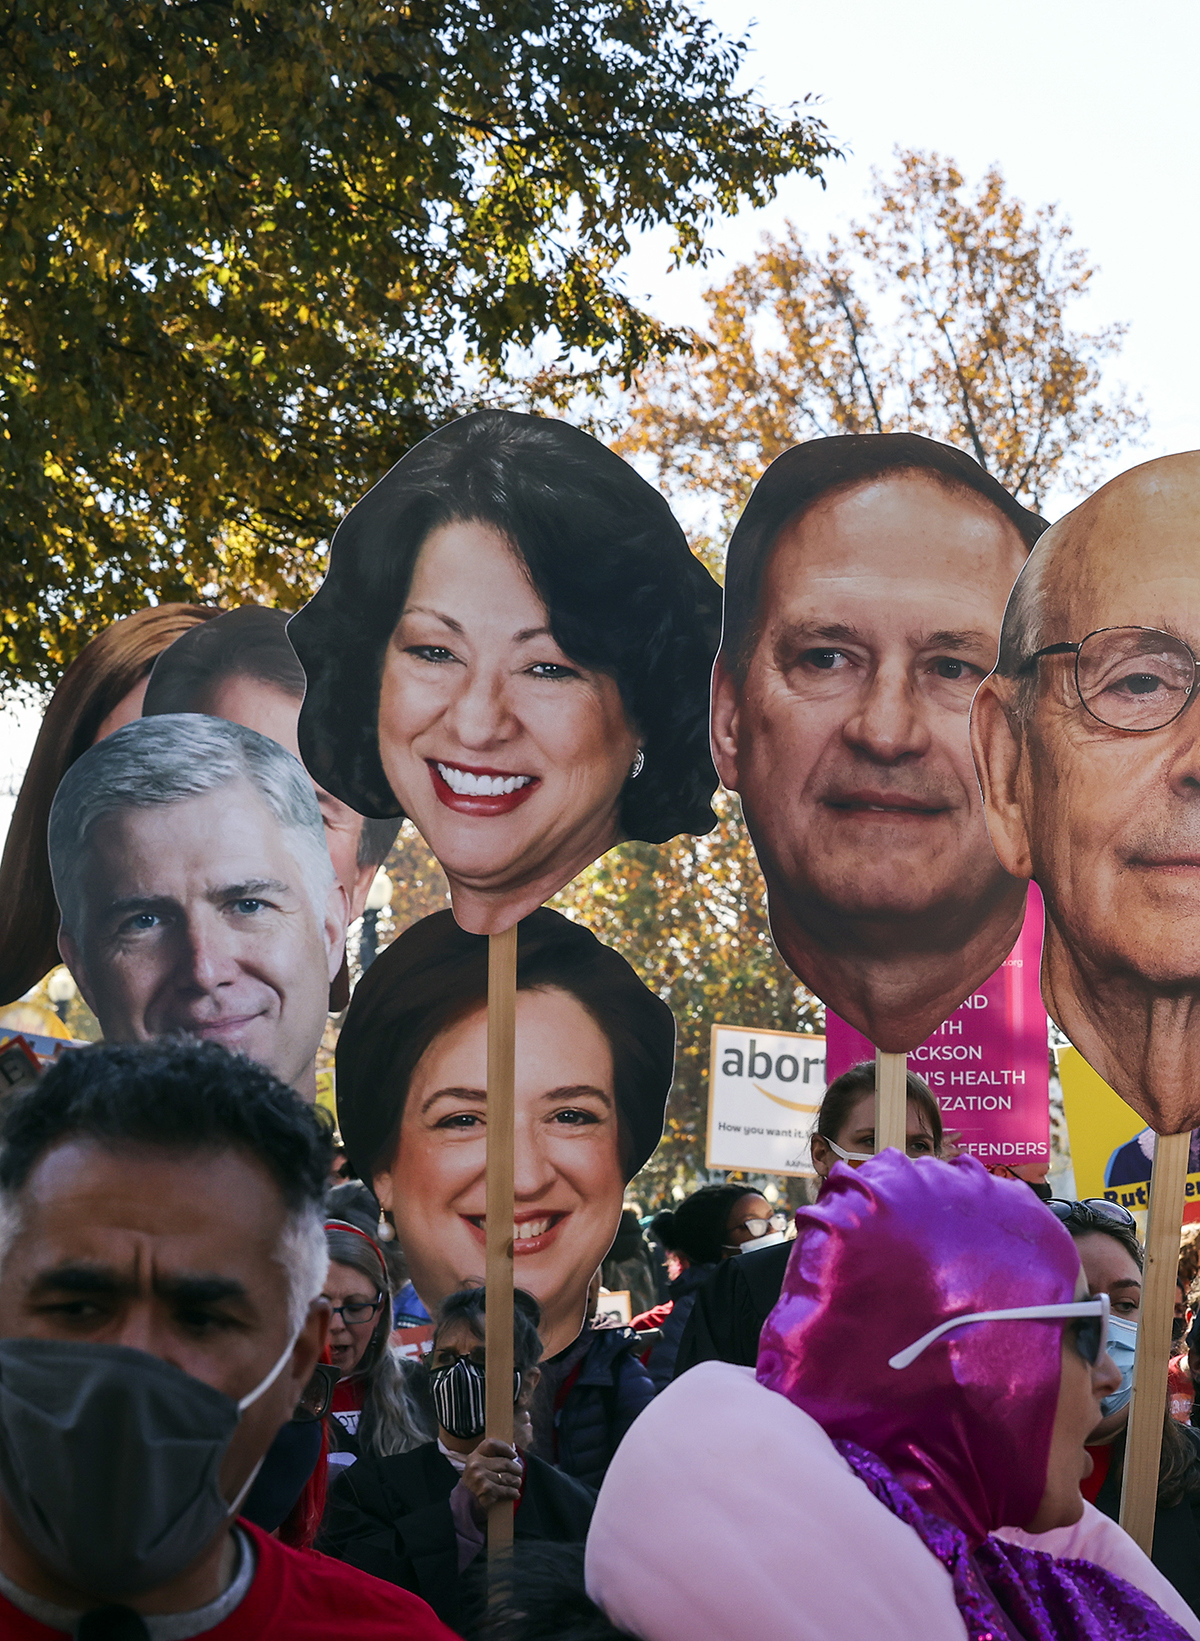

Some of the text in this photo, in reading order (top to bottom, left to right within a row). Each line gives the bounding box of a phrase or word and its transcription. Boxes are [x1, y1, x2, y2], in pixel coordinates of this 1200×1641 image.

[957, 994, 989, 1009] ND
[721, 1038, 825, 1084] abor
[916, 1070, 1026, 1086] N'S HEALTH
[718, 1122, 742, 1132] How
[743, 1125, 764, 1135] you
[766, 1127, 792, 1138] want
[1104, 1182, 1151, 1208] Rut
